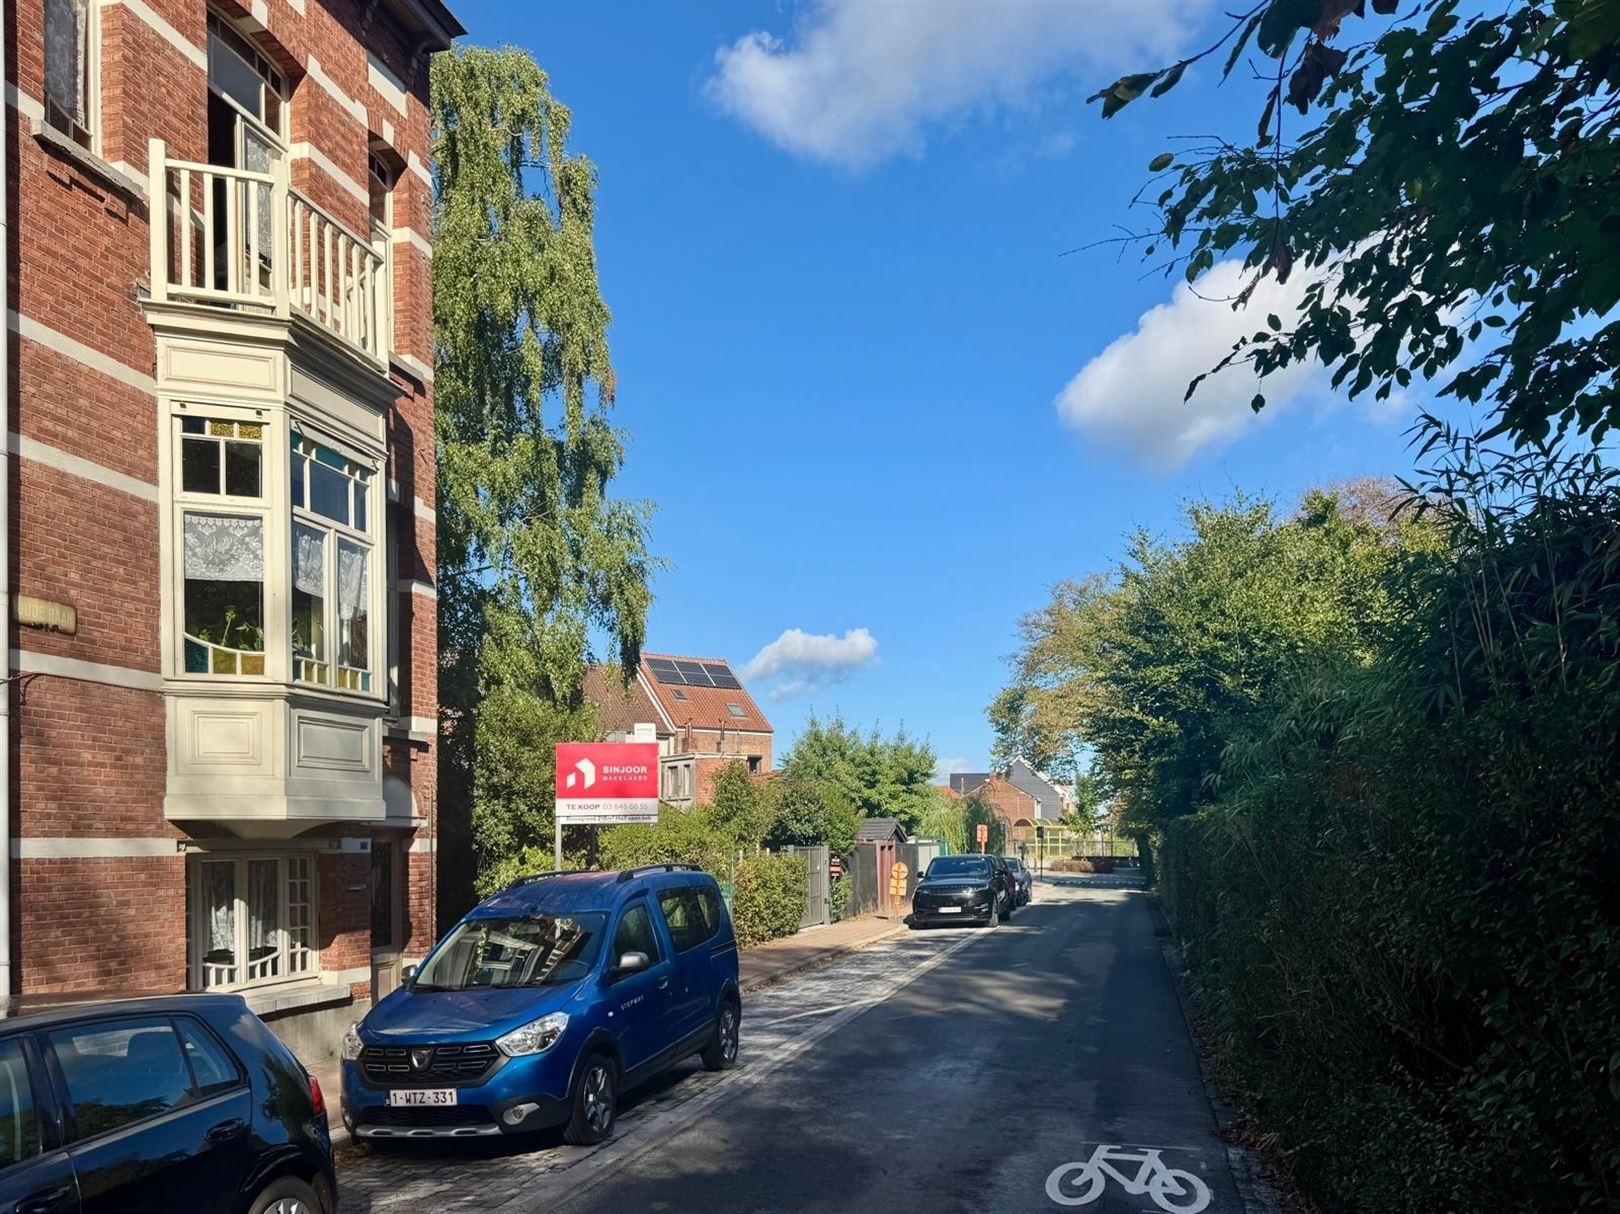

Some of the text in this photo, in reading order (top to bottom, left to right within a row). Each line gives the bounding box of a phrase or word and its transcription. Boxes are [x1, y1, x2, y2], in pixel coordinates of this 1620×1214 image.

[48, 607, 72, 625] BAAN
[602, 765, 648, 774] SINJOOR
[620, 994, 644, 1011] STEPWAY
[392, 1092, 454, 1104] 1-WTZ-331
